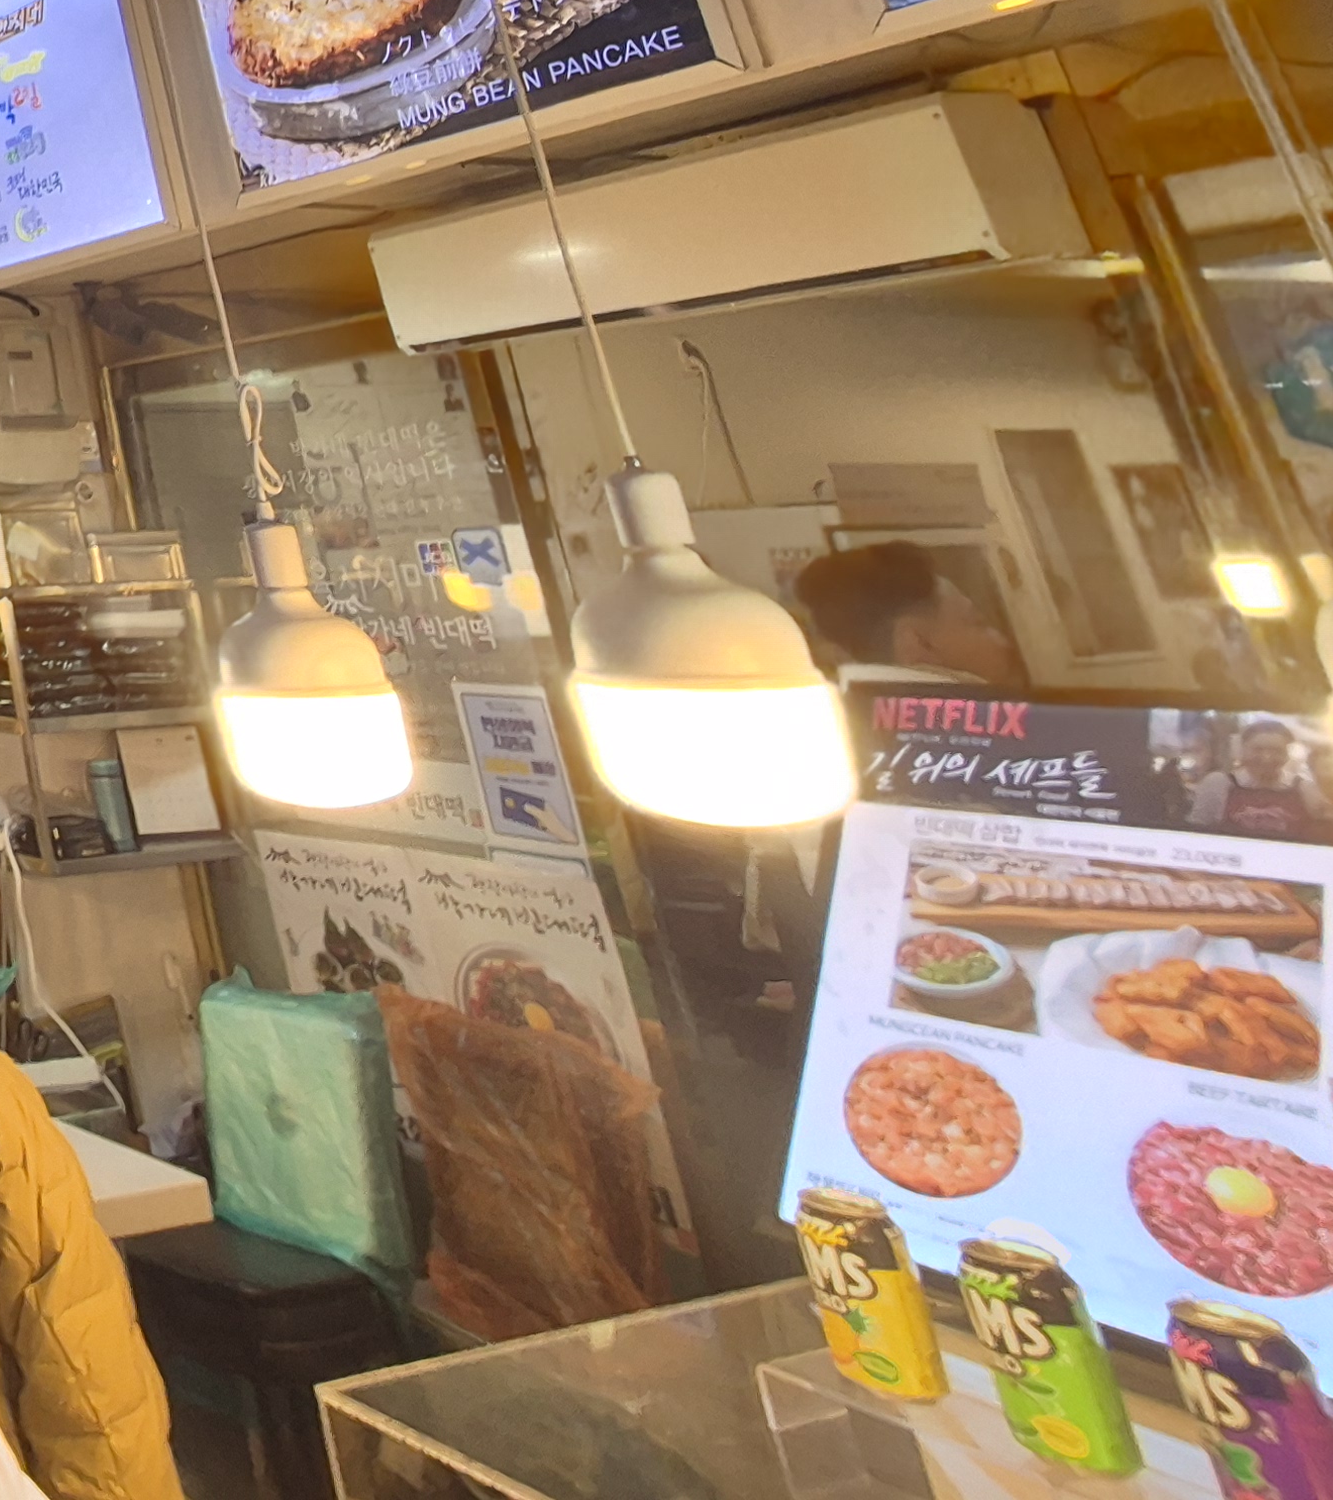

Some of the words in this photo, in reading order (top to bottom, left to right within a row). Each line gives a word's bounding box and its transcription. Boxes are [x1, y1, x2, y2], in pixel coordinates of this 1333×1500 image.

[397, 92, 466, 131] MUNG
[473, 70, 541, 108] BEAN
[548, 25, 684, 85] PANCAKE
[354, 613, 416, 646] 가네
[420, 613, 498, 651] 빈대떡
[872, 696, 1029, 740] NETFLIX
[862, 743, 912, 792] 길
[908, 751, 982, 784] 위의
